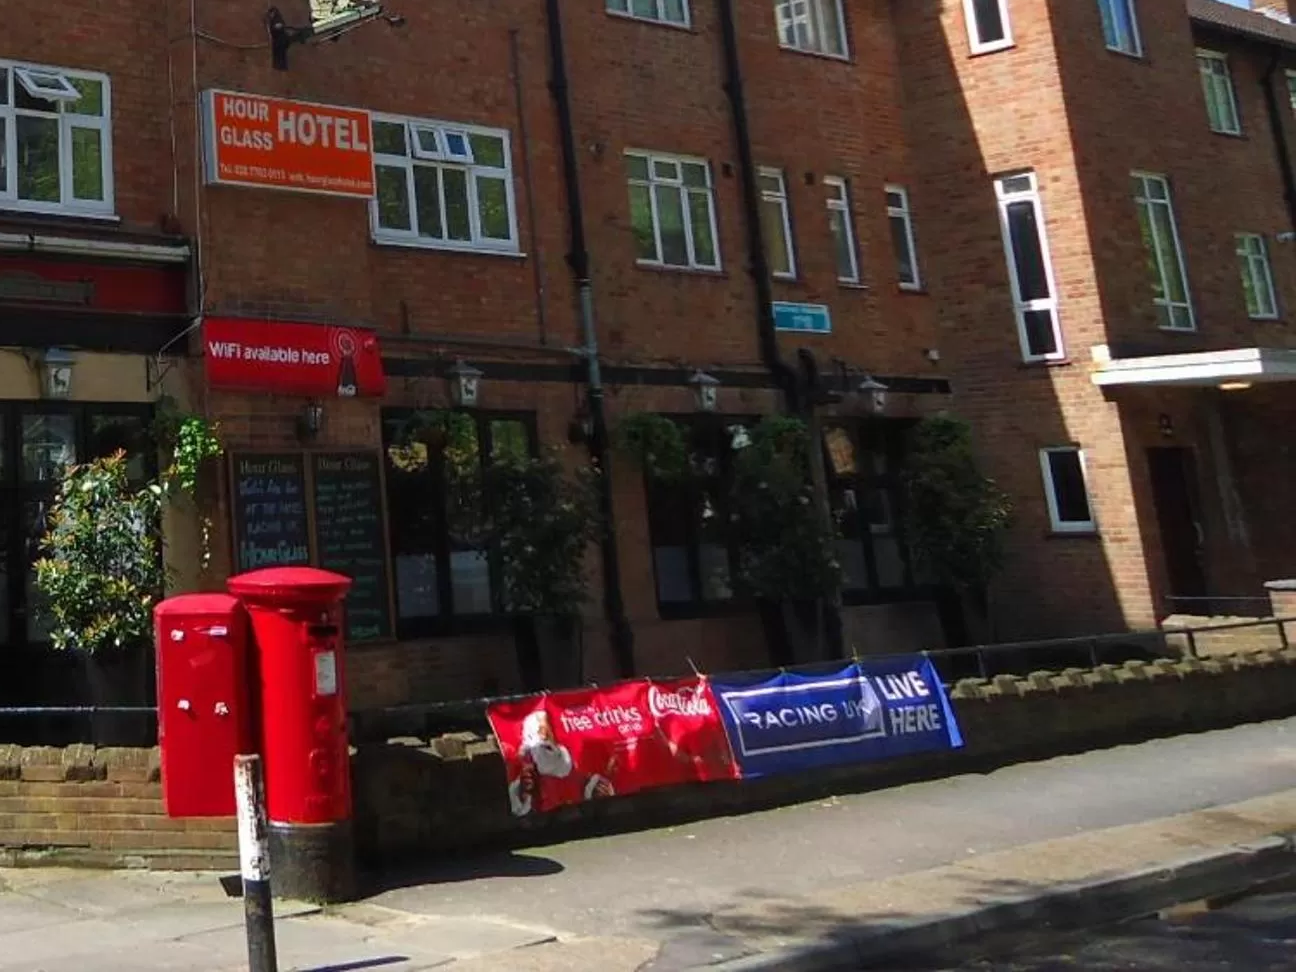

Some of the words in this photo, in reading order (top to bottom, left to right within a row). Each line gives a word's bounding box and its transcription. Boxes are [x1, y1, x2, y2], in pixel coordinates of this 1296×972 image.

[223, 97, 269, 122] HOUR
[220, 125, 273, 151] GLASS
[277, 109, 368, 151] HOTEL
[209, 341, 241, 359] WiFi
[244, 345, 299, 364] available
[302, 349, 330, 365] here
[876, 670, 930, 701] LIVE
[560, 711, 593, 733] free
[593, 705, 643, 727] drinks
[744, 703, 839, 730] RACING
[889, 703, 942, 736] HERE
